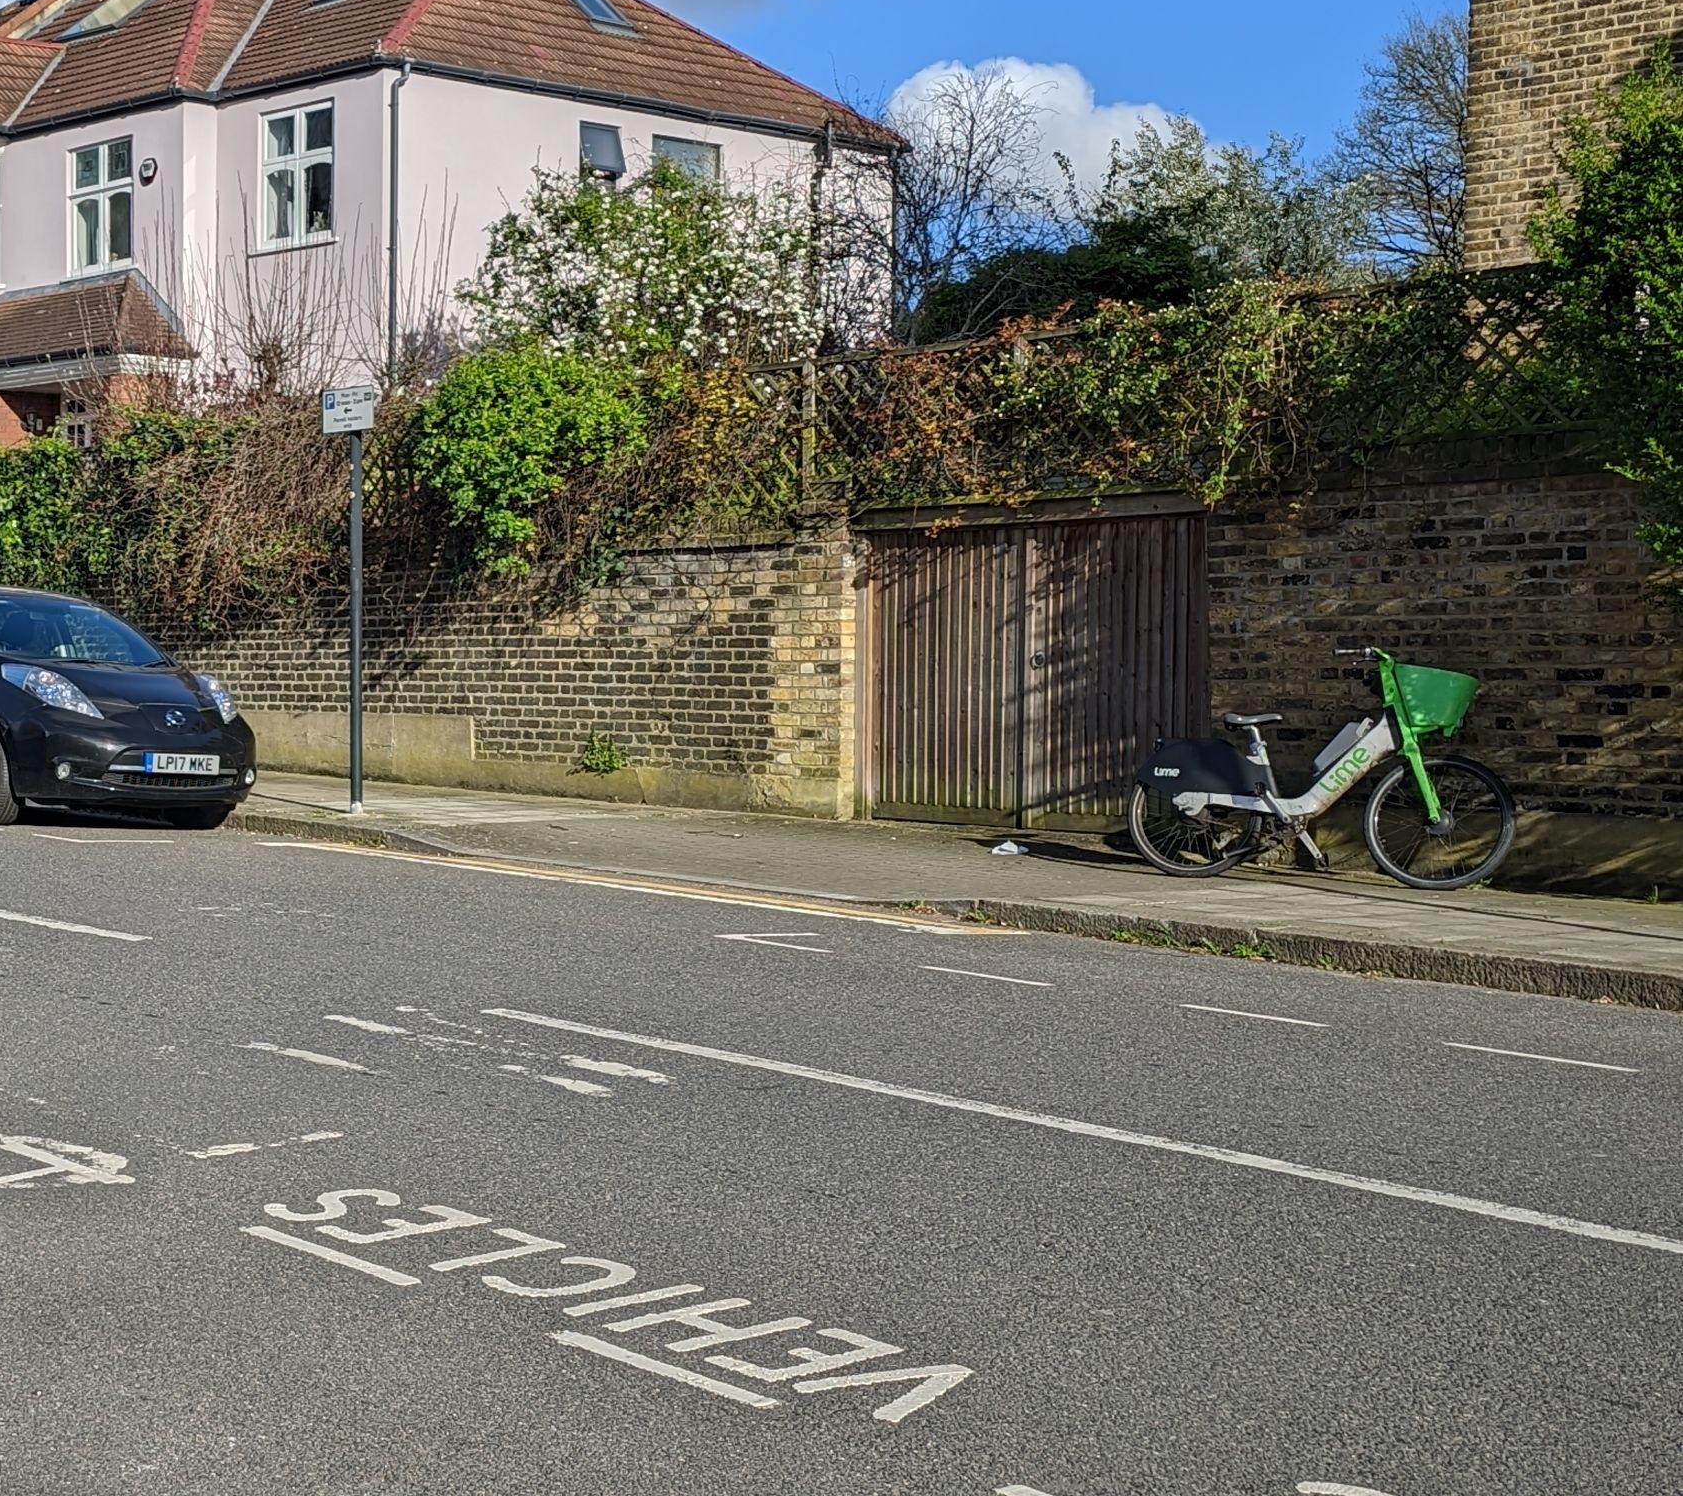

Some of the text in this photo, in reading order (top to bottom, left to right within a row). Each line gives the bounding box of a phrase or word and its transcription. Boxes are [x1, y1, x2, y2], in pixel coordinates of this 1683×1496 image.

[157, 755, 214, 772] LP17 MKE
[262, 1187, 974, 1424] VEHICLES
